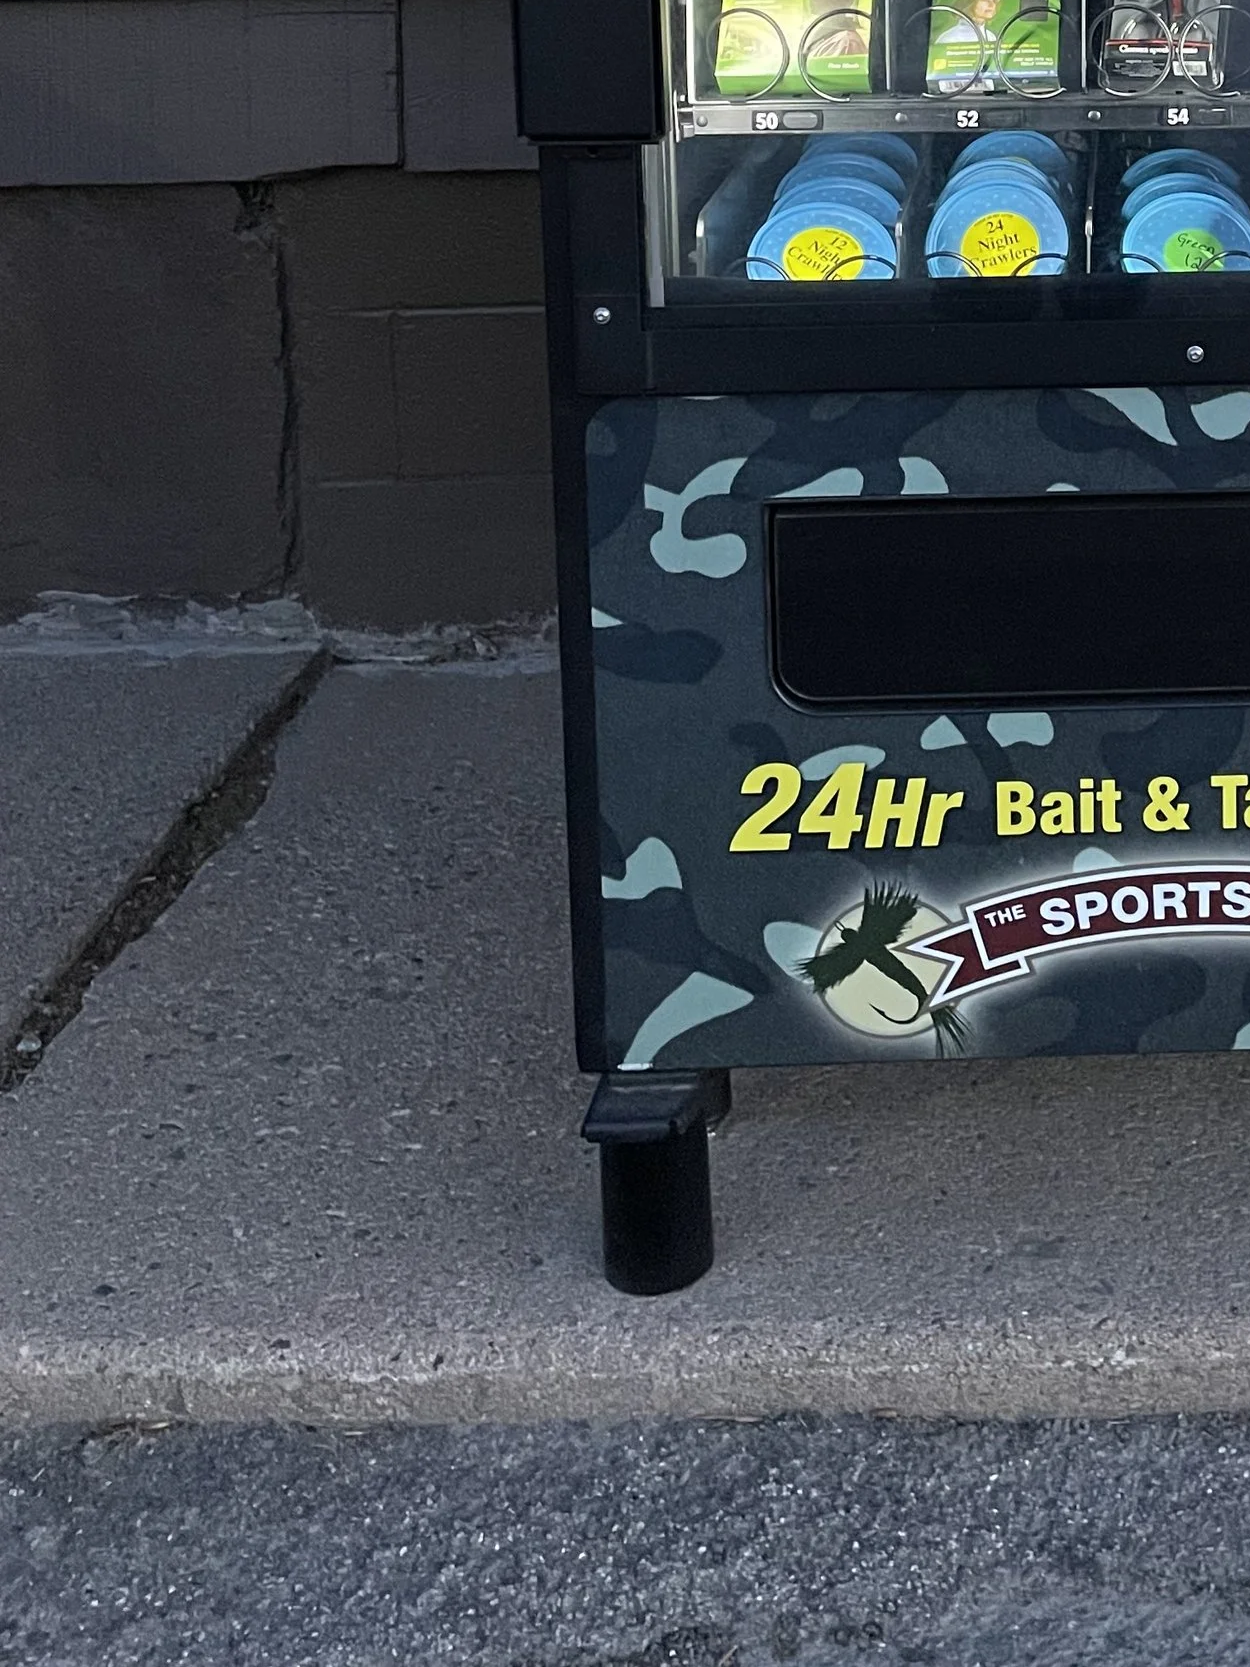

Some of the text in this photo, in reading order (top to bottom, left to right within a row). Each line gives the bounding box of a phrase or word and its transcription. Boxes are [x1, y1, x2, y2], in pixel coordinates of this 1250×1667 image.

[755, 113, 779, 130] 50
[956, 110, 979, 128] 52
[1167, 108, 1190, 126] 54
[986, 218, 1004, 234] 24
[808, 240, 841, 265] Nigh
[829, 236, 848, 251] 12
[978, 233, 1020, 254] Night
[1177, 232, 1215, 255] Green
[729, 761, 964, 852] 24Hr
[996, 778, 1123, 836] Bait
[1142, 776, 1190, 832] &
[984, 904, 1026, 928] THE
